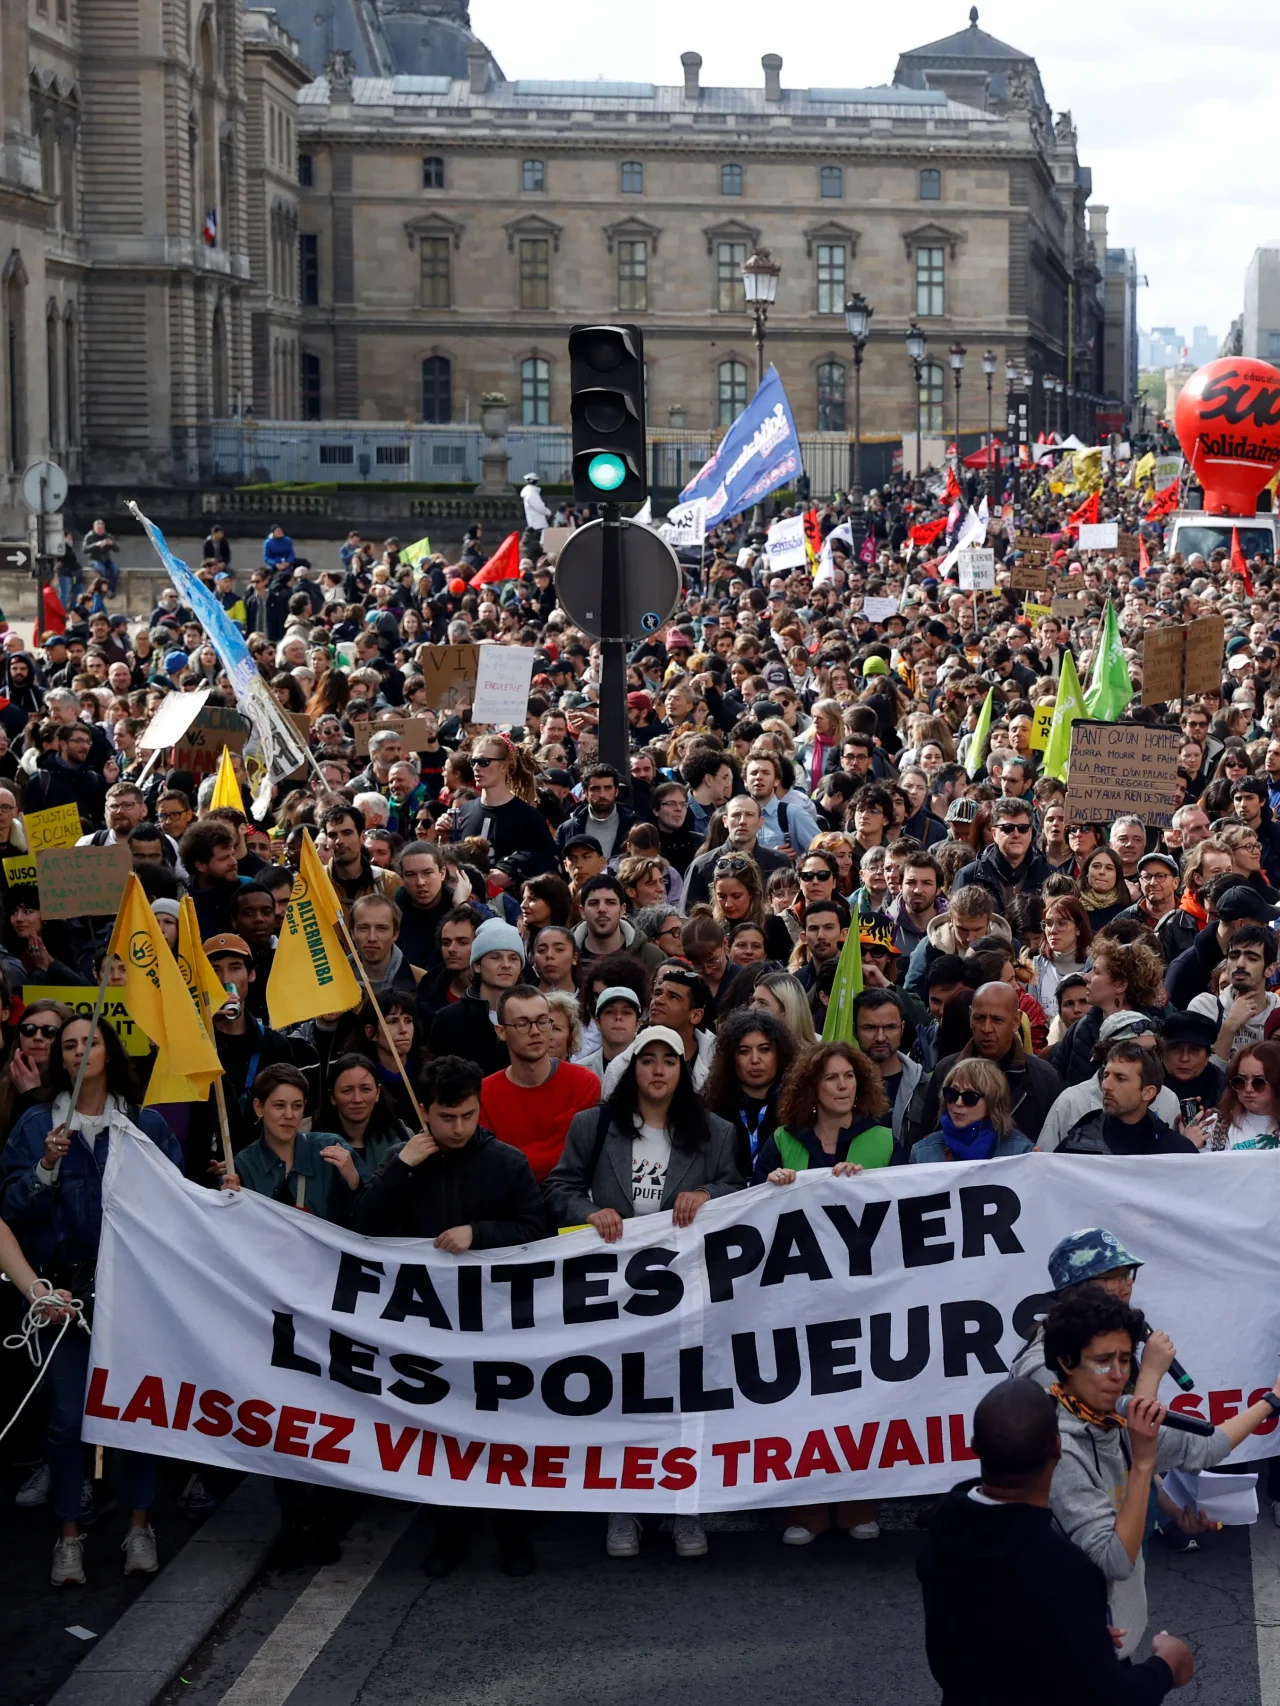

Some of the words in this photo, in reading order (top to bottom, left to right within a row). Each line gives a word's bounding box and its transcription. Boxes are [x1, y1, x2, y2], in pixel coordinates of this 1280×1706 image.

[1073, 726, 1107, 745] TANT
[1108, 728, 1139, 745] QU'UN
[1144, 732, 1180, 749] HOMME
[1070, 745, 1102, 757] POURRA
[1141, 753, 1153, 762] DE
[1089, 775, 1111, 785] TOUT
[1093, 763, 1118, 777] PORTE
[1069, 787, 1083, 799] IL
[1102, 789, 1122, 800] AURA
[32, 805, 79, 828] JUSTICE
[1090, 806, 1103, 820] LES
[31, 821, 83, 848] SOCIALE
[41, 849, 117, 875] ARRÊTEZ
[296, 899, 334, 988] ALTERNATIBA
[331, 1246, 685, 1333] FAITES
[704, 1184, 1025, 1302] PAYER
[270, 1310, 450, 1404] LES
[84, 1367, 356, 1465] LAISSEZ
[373, 1421, 567, 1488] VIVRE
[582, 1446, 697, 1491] LES
